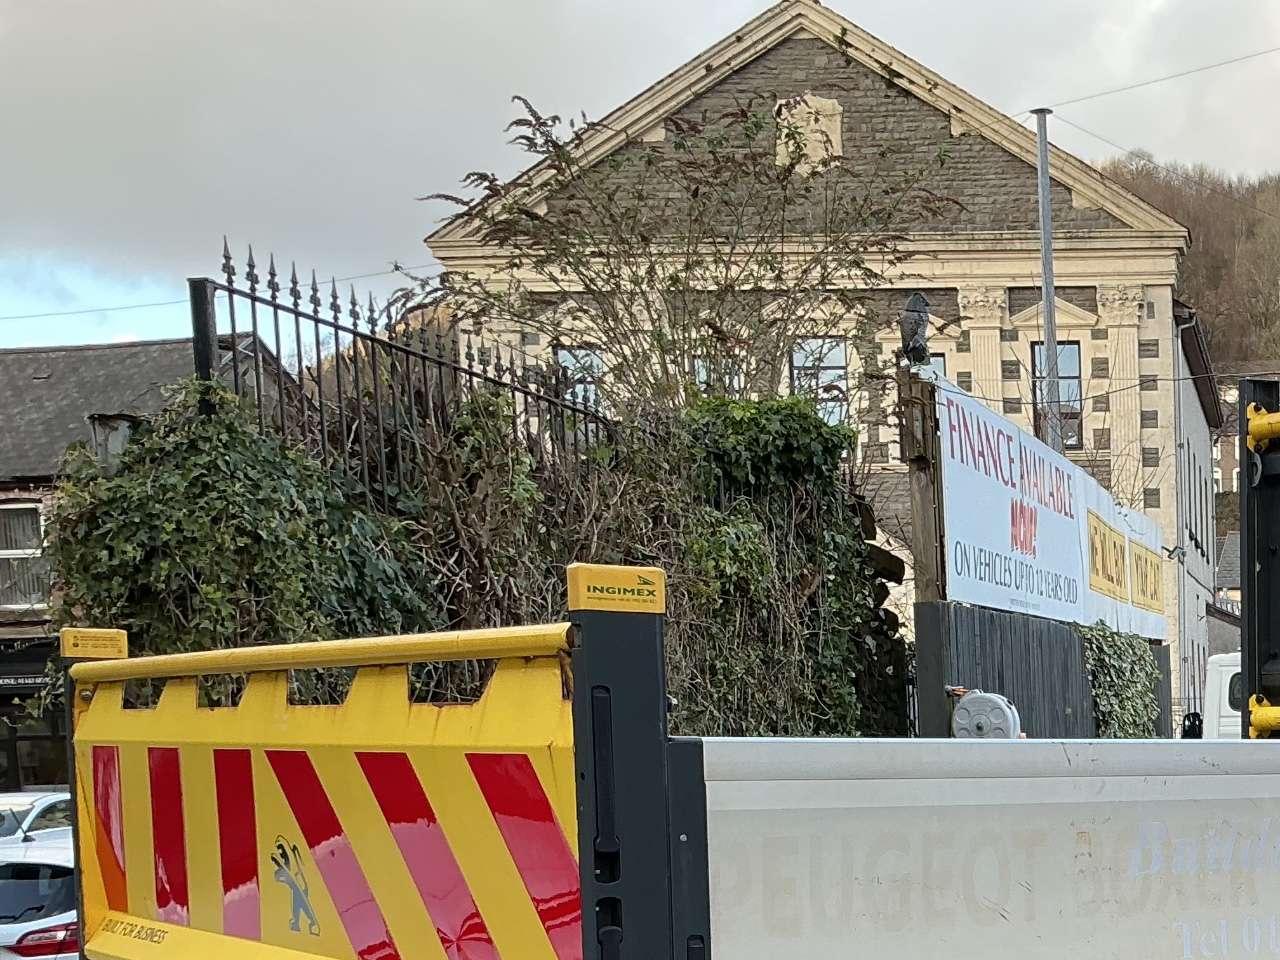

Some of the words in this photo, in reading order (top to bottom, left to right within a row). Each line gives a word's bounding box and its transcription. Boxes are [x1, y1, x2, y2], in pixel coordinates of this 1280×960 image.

[946, 397, 1017, 490] FINANCE
[1019, 440, 1075, 520] AVAILABLE
[586, 584, 657, 598] INGIMEX
[954, 540, 971, 579] ON
[972, 546, 1012, 589] VEHICLES
[1036, 567, 1043, 597] 12
[1044, 569, 1062, 601] YEARS
[1063, 574, 1078, 605] OLD
[102, 918, 124, 934] BUILT
[120, 922, 138, 938] FOR
[134, 926, 169, 945] BUSINESS
[1173, 918, 1230, 960] Tel
